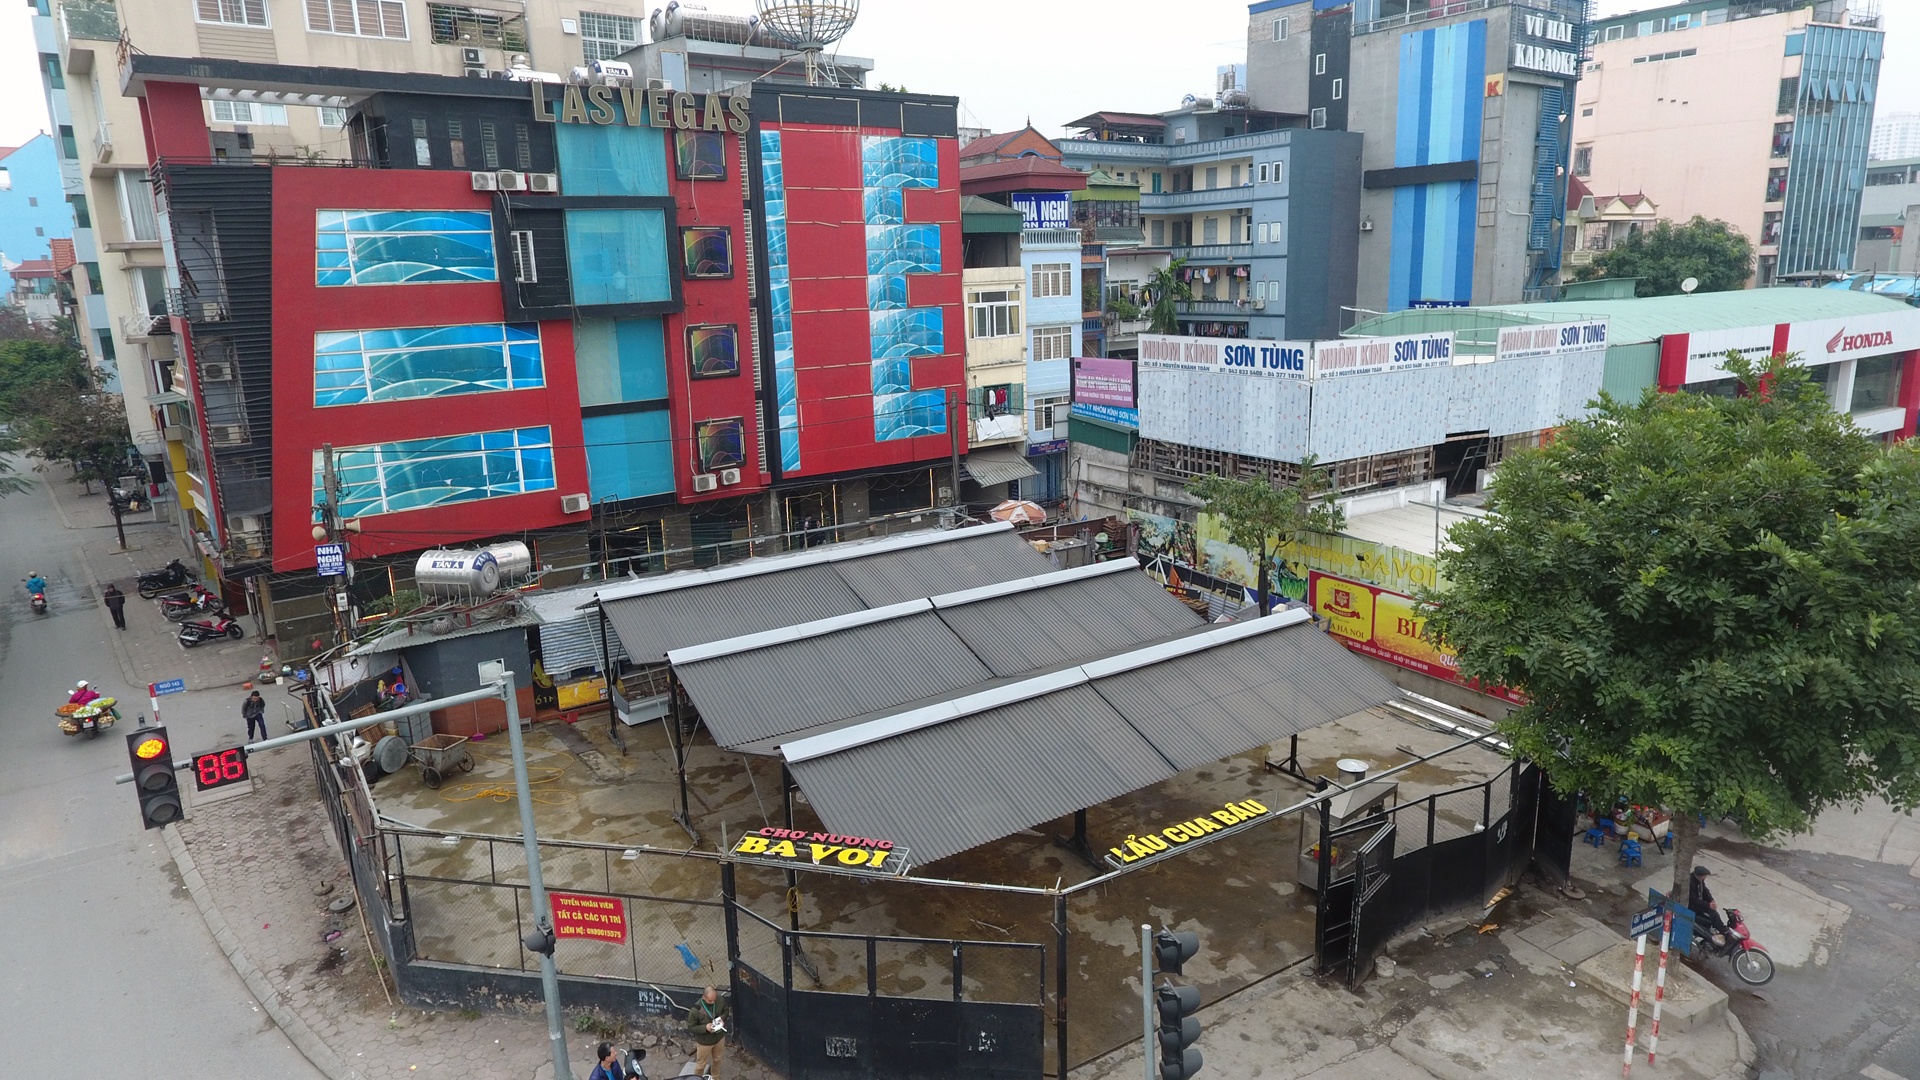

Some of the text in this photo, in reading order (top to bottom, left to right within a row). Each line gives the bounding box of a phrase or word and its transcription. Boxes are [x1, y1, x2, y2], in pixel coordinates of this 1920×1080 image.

[1525, 13, 1573, 43] VŨ HẢI
[1513, 43, 1577, 76] KARAOKE
[1487, 80, 1500, 97] K
[531, 81, 751, 133] LAS VEGAS
[1013, 193, 1069, 221] NHÀ NGHỈ
[1534, 325, 1558, 349] KÍNH
[1560, 325, 1580, 346] SƠN
[1582, 321, 1606, 344] TÙNG
[1841, 330, 1894, 352] HONDA
[1142, 338, 1304, 371] NHÔM KÍNH SƠN TÙNG
[1319, 335, 1450, 370] NHÔM KÍNH SƠN TÙNG
[1392, 556, 1437, 588] VOI
[197, 749, 244, 785] 86
[759, 827, 807, 842] CHỢ
[1109, 834, 1168, 863] LẨU
[1162, 817, 1223, 843] CUA
[736, 836, 890, 868] BA VOI
[556, 908, 571, 920] TẤT
[572, 910, 583, 921] CẢ
[583, 911, 600, 922] CÁC
[580, 899, 598, 908] NHÂN
[599, 901, 614, 910] VIÊN
[560, 925, 575, 934] LIÊN
[575, 926, 586, 936] HỆ:
